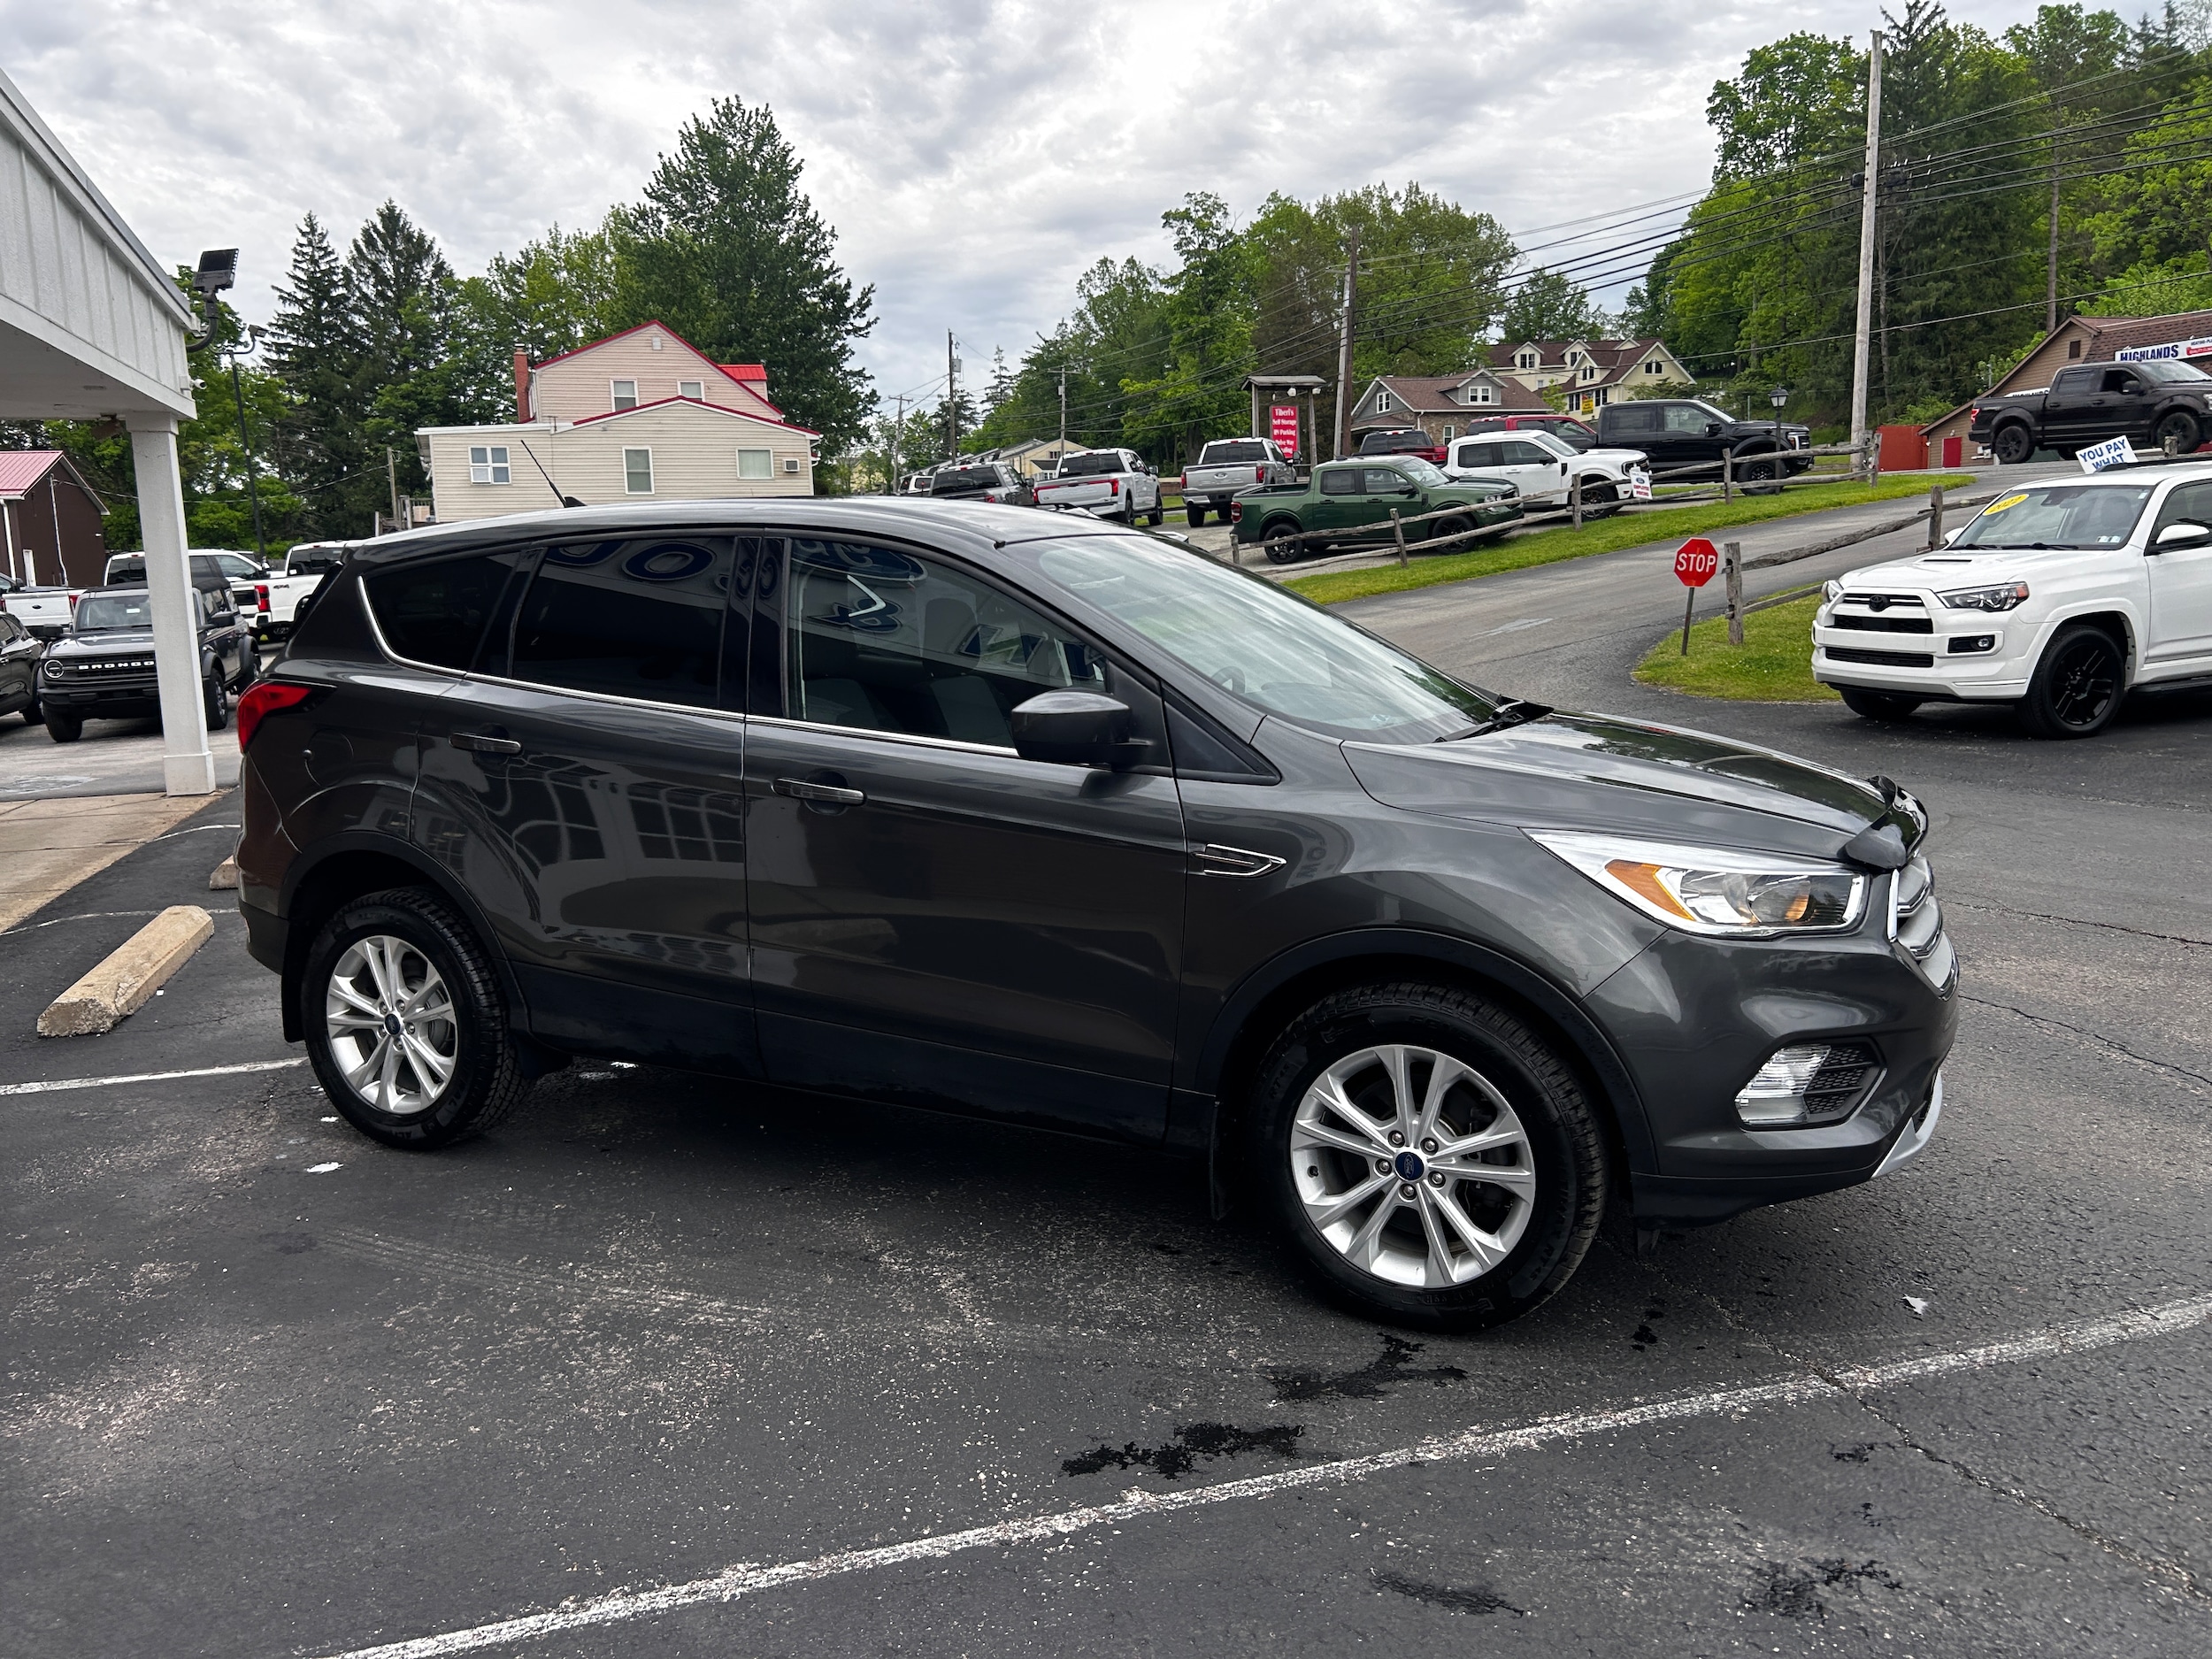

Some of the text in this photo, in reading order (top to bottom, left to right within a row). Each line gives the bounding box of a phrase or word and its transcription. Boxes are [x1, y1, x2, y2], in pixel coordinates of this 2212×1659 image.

[2120, 345, 2179, 362] HIGHLANDS
[2079, 439, 2126, 463] YOU PAY
[1677, 553, 1717, 573] STOP
[78, 661, 155, 670] BRONCO
